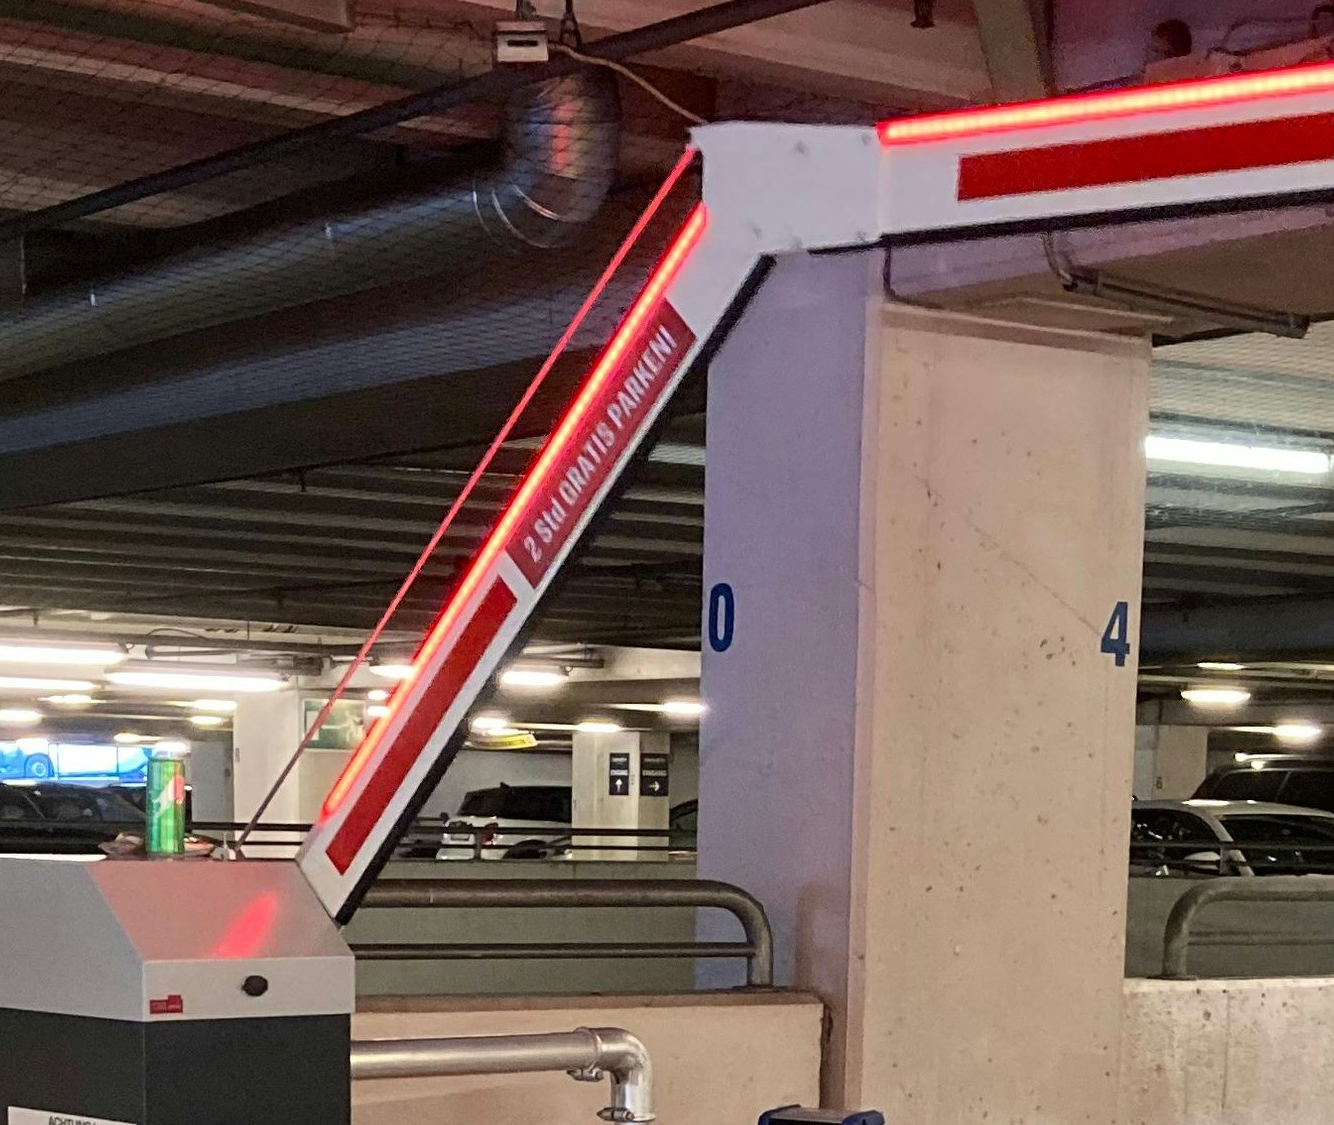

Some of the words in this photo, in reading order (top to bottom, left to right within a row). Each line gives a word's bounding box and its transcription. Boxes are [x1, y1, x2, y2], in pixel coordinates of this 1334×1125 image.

[524, 536, 542, 562] 2
[534, 499, 567, 544] Std
[559, 421, 615, 506] GRATIS
[1100, 601, 1131, 668] 4
